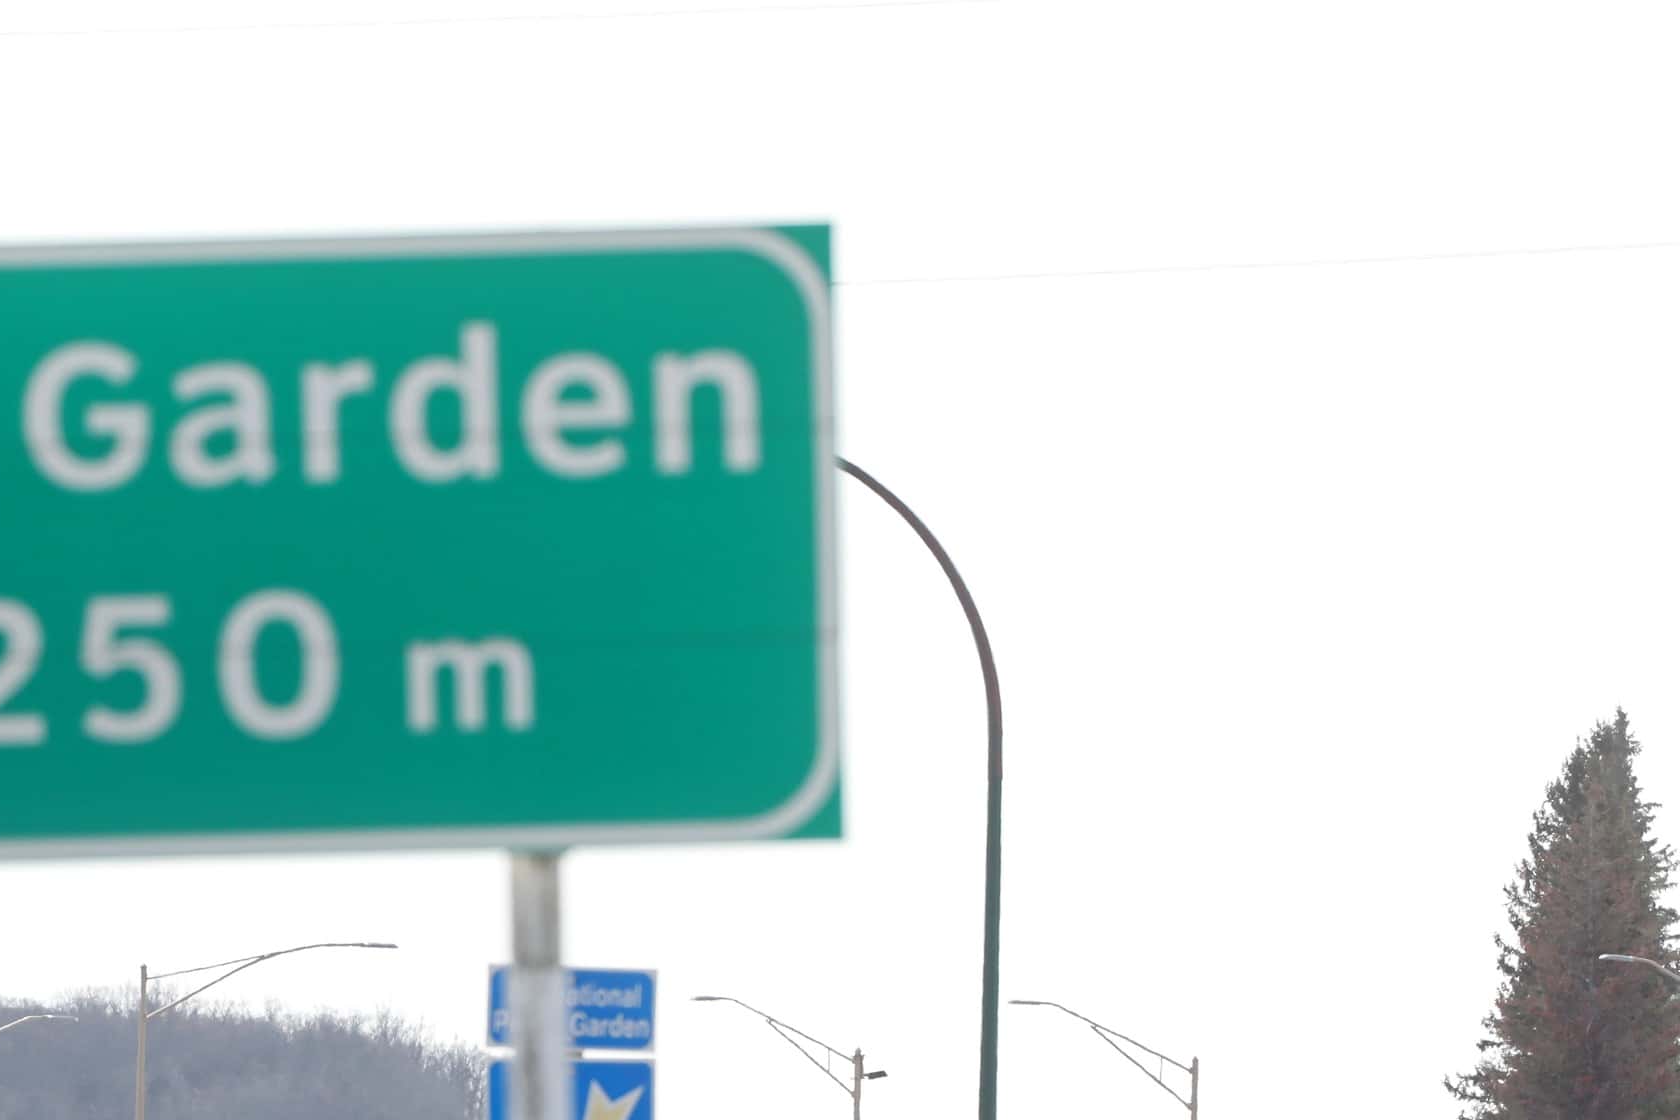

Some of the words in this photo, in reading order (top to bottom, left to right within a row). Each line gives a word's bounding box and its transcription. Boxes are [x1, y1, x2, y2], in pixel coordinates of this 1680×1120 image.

[21, 320, 766, 494] Garden
[402, 632, 537, 736] m
[571, 1011, 651, 1038] Garden
